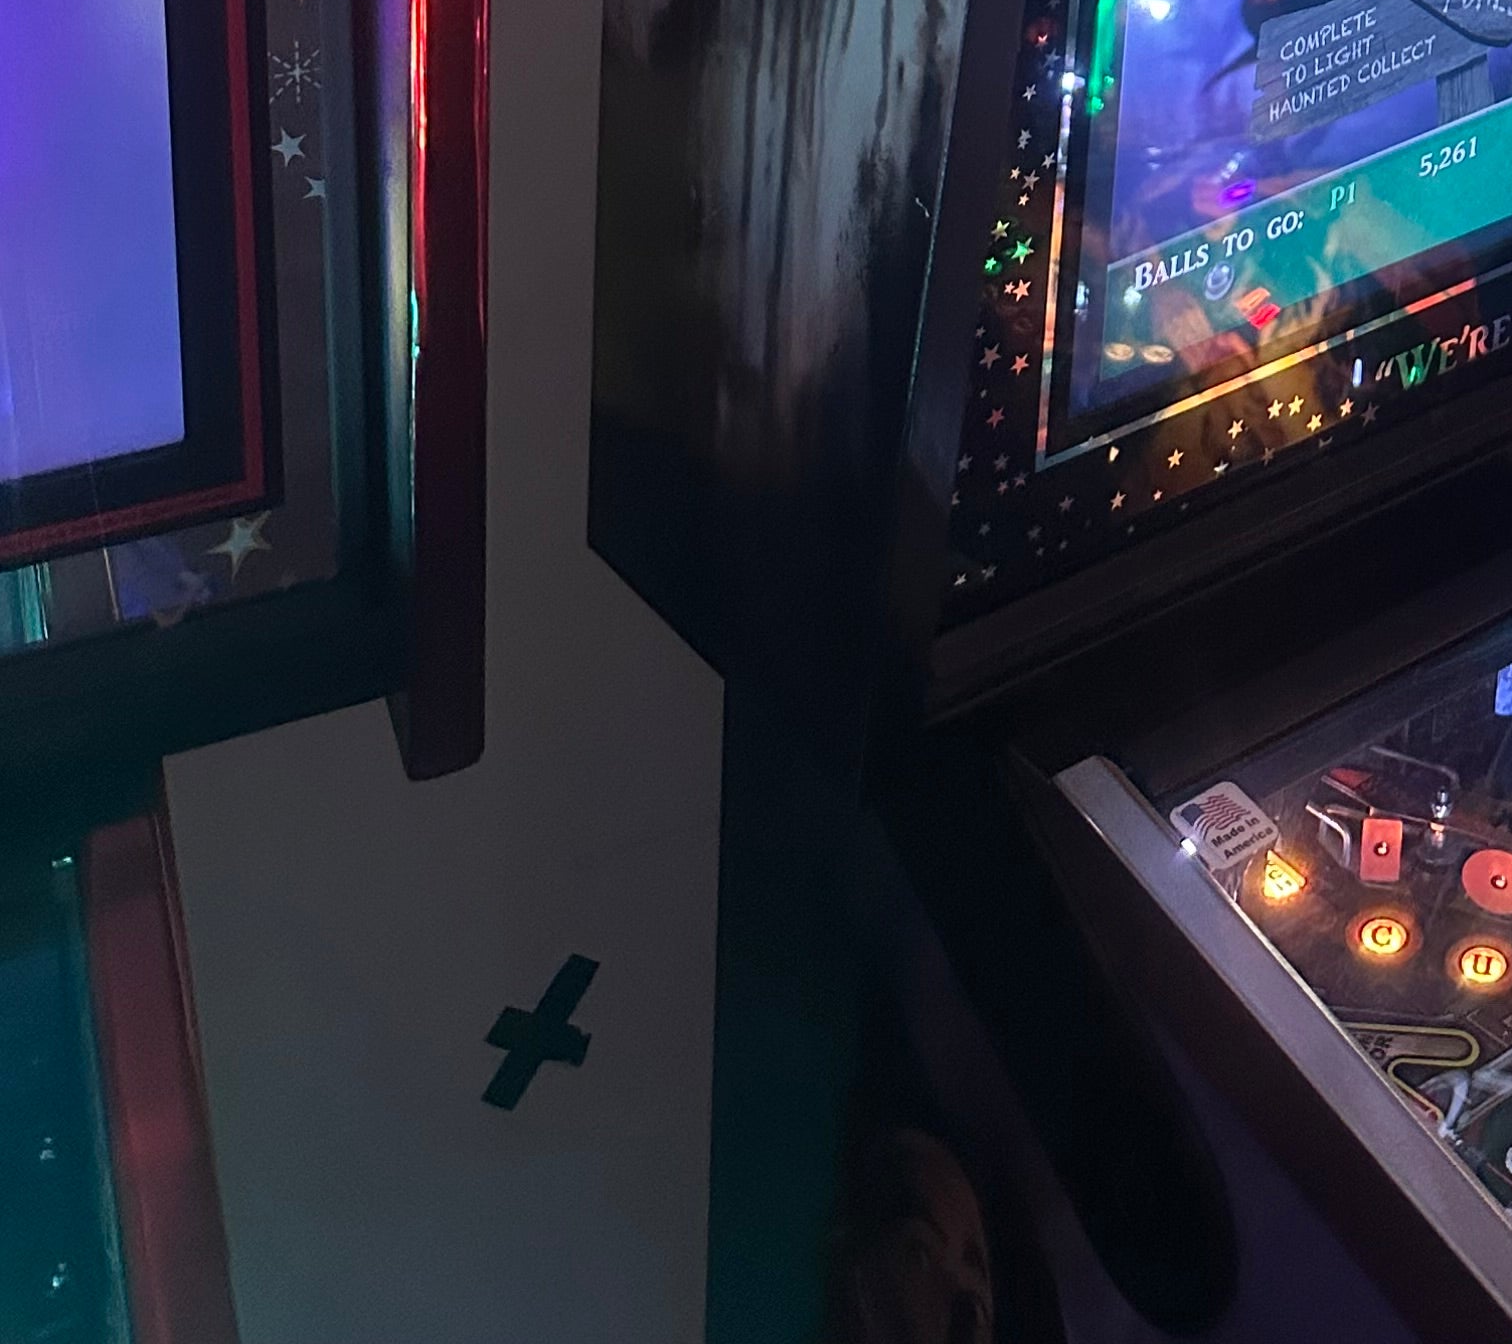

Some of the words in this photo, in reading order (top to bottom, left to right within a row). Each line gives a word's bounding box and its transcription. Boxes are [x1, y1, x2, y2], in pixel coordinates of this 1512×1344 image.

[1279, 5, 1378, 61] COMPLETE
[1268, 73, 1352, 124] HAUNTED
[1357, 34, 1437, 84] COLLECT
[1281, 62, 1308, 90] TO
[1314, 34, 1376, 77] LIGHT
[1328, 180, 1358, 212] P1
[1417, 135, 1480, 179] 5,261
[1131, 241, 1210, 293] BALLS
[1222, 227, 1256, 258] TO
[1265, 209, 1306, 241] GO:
[1210, 824, 1246, 848] Made
[1223, 825, 1274, 860] America
[1370, 924, 1393, 948] C
[1471, 953, 1494, 977] U
